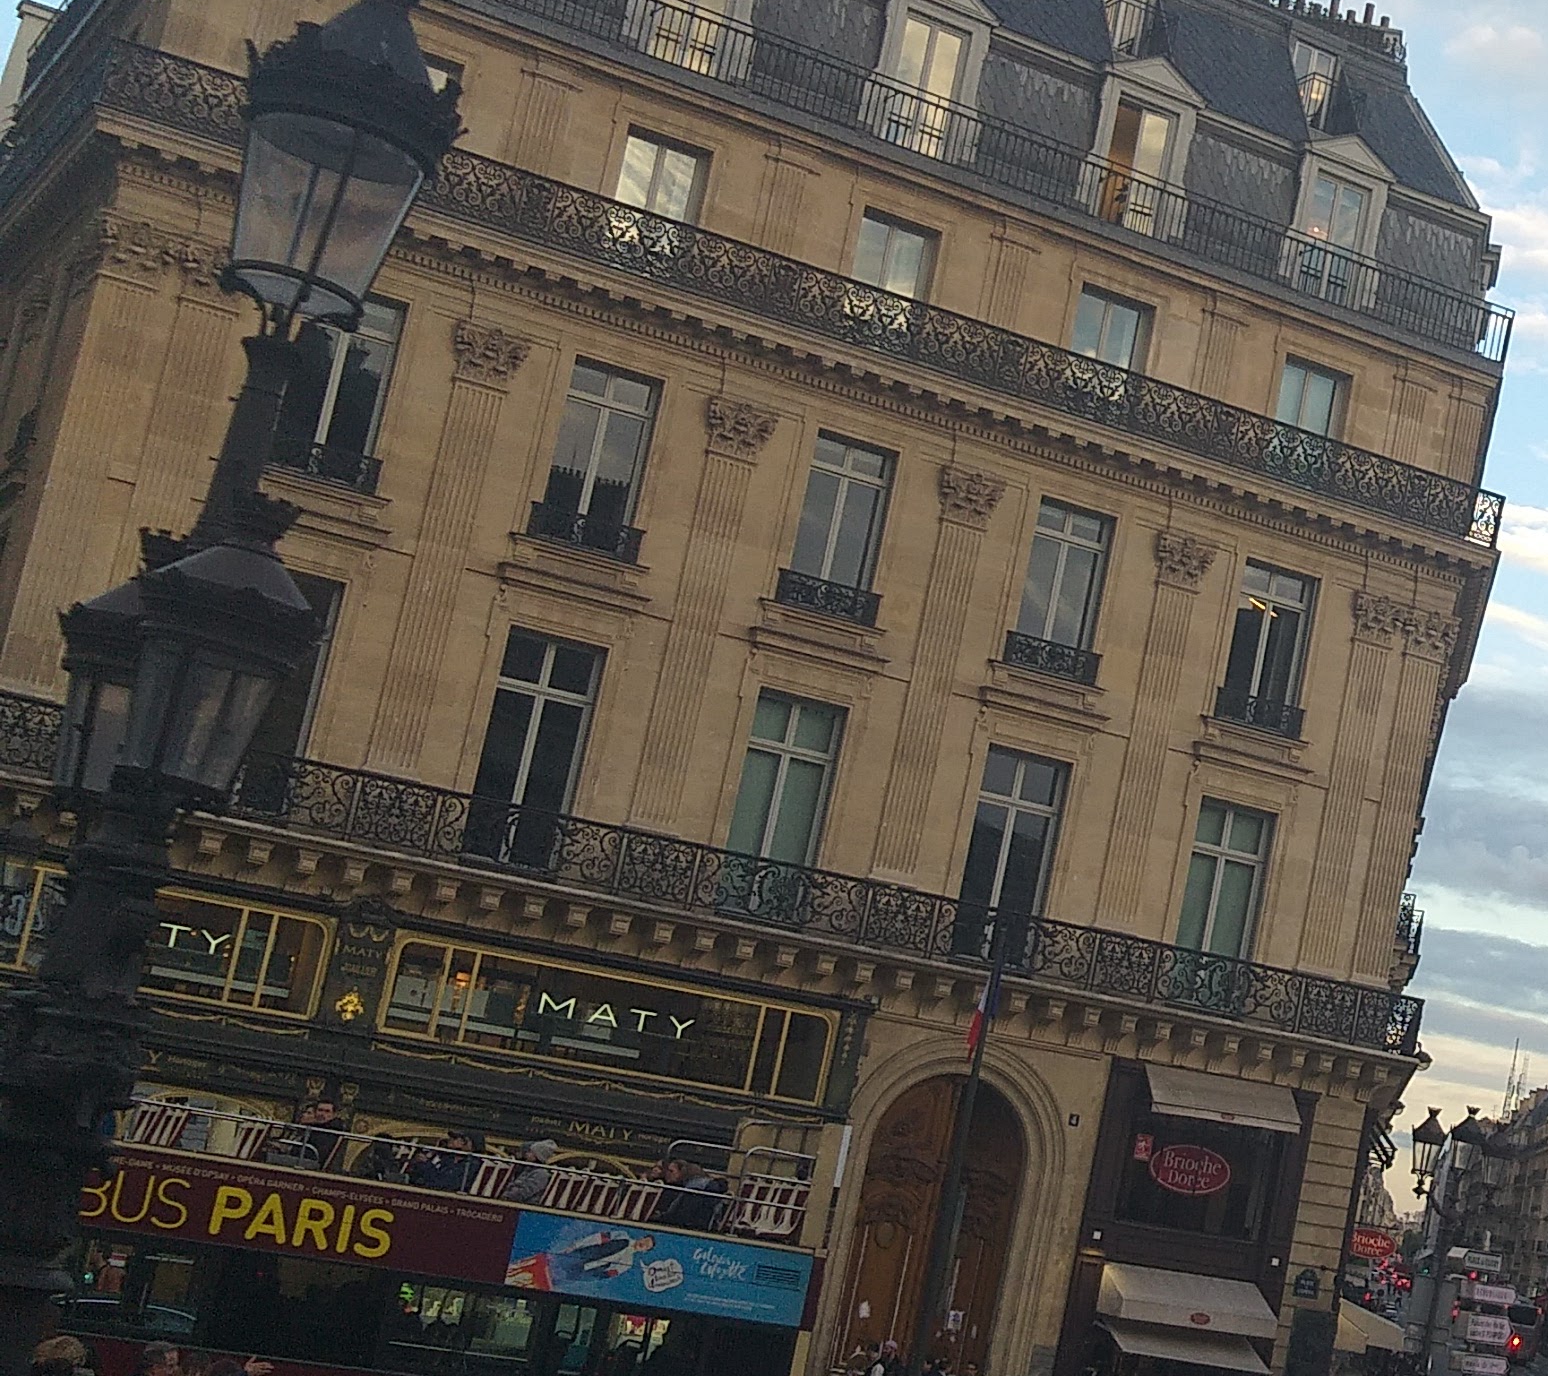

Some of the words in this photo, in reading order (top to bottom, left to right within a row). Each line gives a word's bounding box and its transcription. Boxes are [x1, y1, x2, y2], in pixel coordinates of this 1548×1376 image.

[160, 922, 232, 955] TY
[343, 944, 383, 959] MATY
[537, 992, 695, 1040] MATY
[1163, 1150, 1221, 1175] Brioche
[208, 1185, 395, 1258] PARIS
[420, 1202, 449, 1215] PALAIS
